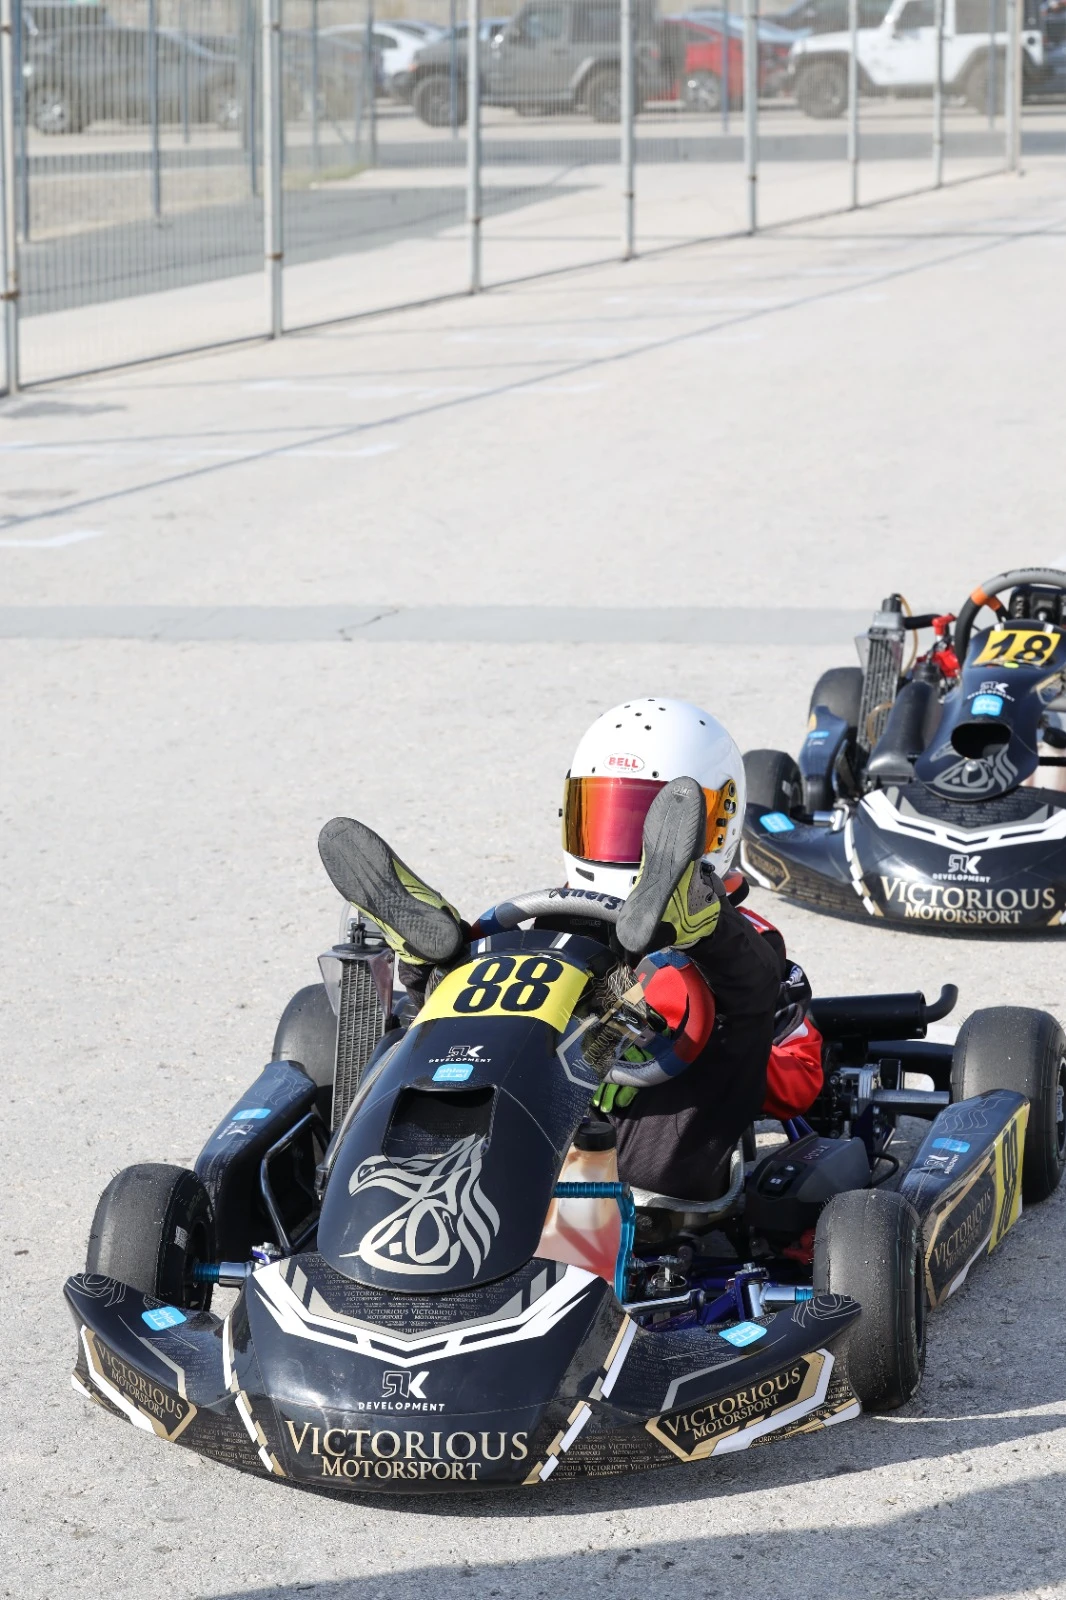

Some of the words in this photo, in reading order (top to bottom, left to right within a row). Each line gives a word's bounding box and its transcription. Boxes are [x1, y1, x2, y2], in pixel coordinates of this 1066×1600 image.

[990, 633, 1052, 662] 18
[608, 757, 639, 769] BELL
[880, 876, 1056, 910] VICTORIOUS
[932, 873, 991, 884] DEVELOPMENT
[904, 900, 1023, 924] MOTORSPORT
[452, 956, 564, 1014] 88
[933, 1184, 991, 1267] VICTORIOUS
[95, 1341, 184, 1420] VICTORIOUS
[111, 1369, 166, 1419] MOTORSPORT
[358, 1401, 446, 1412] DEVELOPMENT
[665, 1367, 801, 1437] VICTORIOUS
[693, 1393, 781, 1441] MOTORSPORT
[285, 1420, 529, 1461] VICTORIOUS
[321, 1457, 482, 1481] MOTORSPORT
